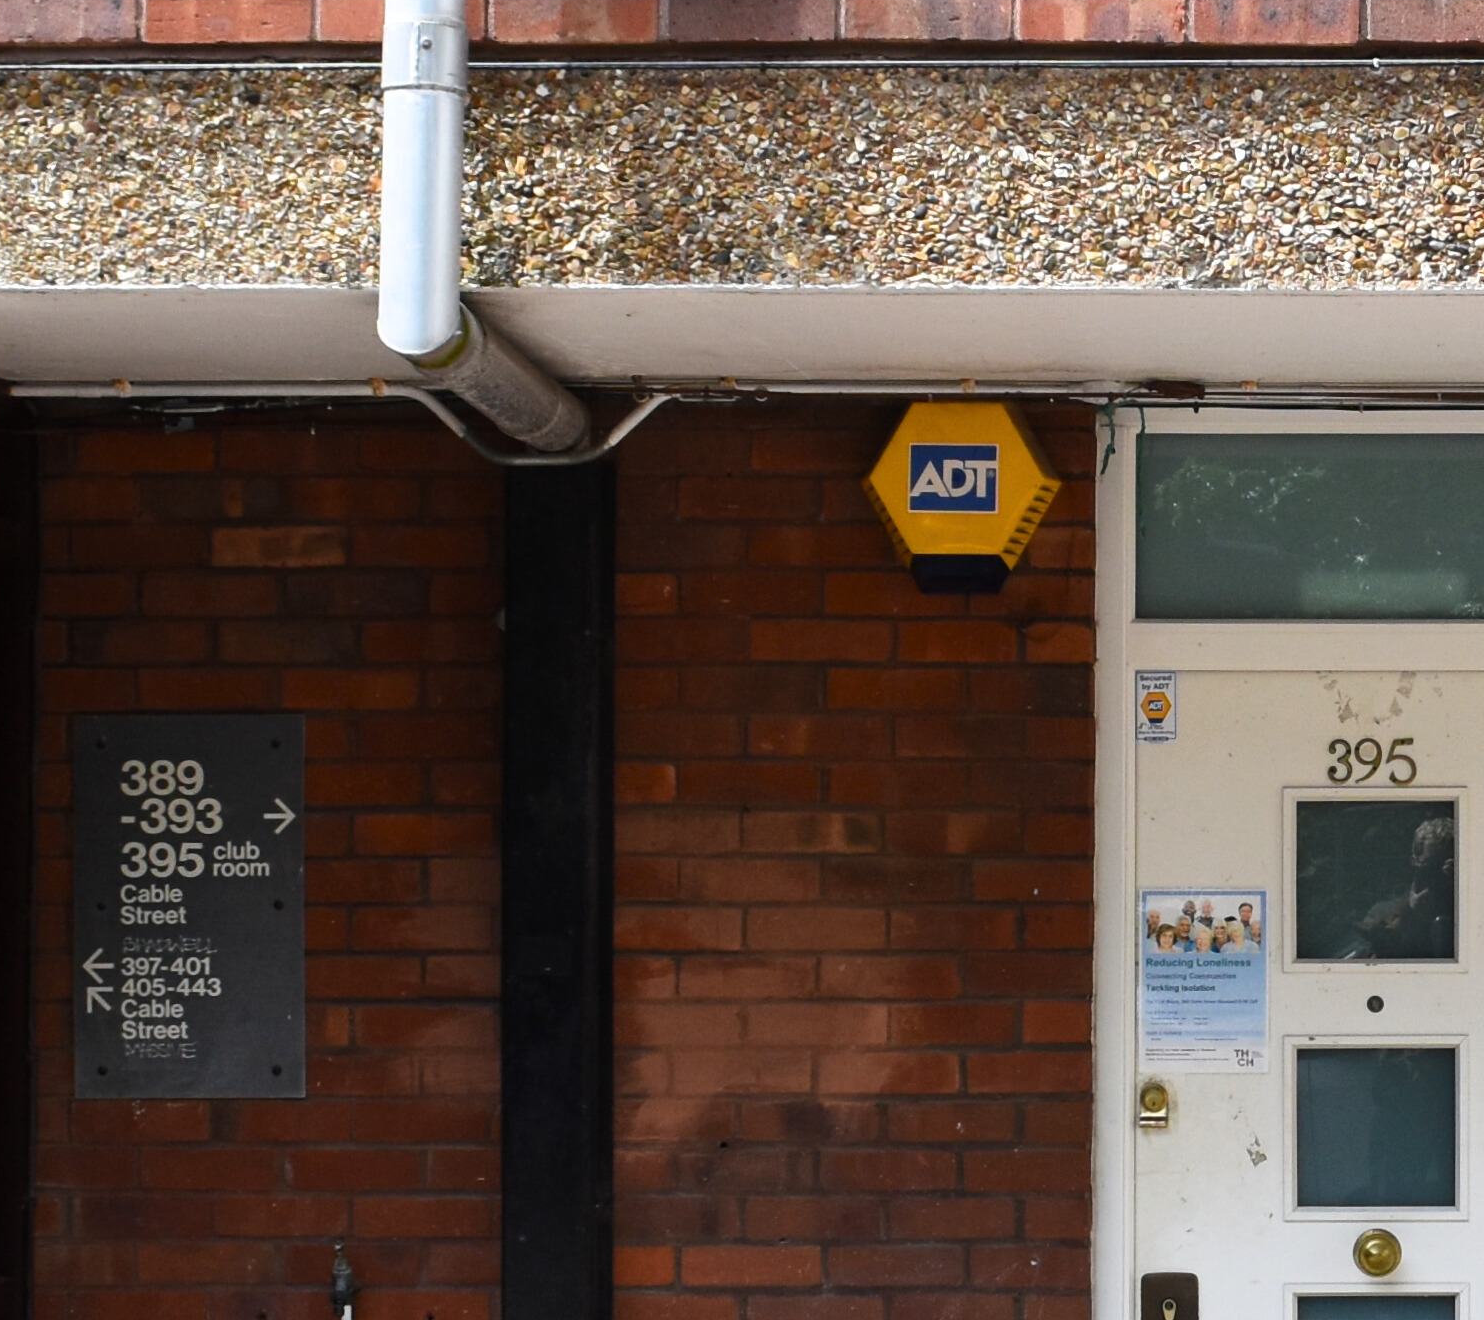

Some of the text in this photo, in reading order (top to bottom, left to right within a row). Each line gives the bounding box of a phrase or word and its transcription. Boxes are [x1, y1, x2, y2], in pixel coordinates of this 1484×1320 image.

[909, 459, 998, 498] ADT
[1148, 701, 1163, 710] ADT
[1327, 737, 1418, 786] 395
[120, 759, 205, 796] 389
[120, 798, 224, 835] -393
[120, 841, 260, 878] 395 club
[213, 862, 270, 877] room
[120, 884, 183, 904] Cable
[120, 905, 187, 925] Street
[121, 956, 211, 976] 397-401
[1146, 958, 1252, 968] Reducing Loneliness
[121, 977, 222, 997] 405-443
[1146, 984, 1216, 993] Tackling Isolation
[121, 999, 184, 1018] Cable
[121, 1020, 189, 1040] Street
[1233, 1049, 1250, 1058] TH
[1236, 1058, 1254, 1067] CH
